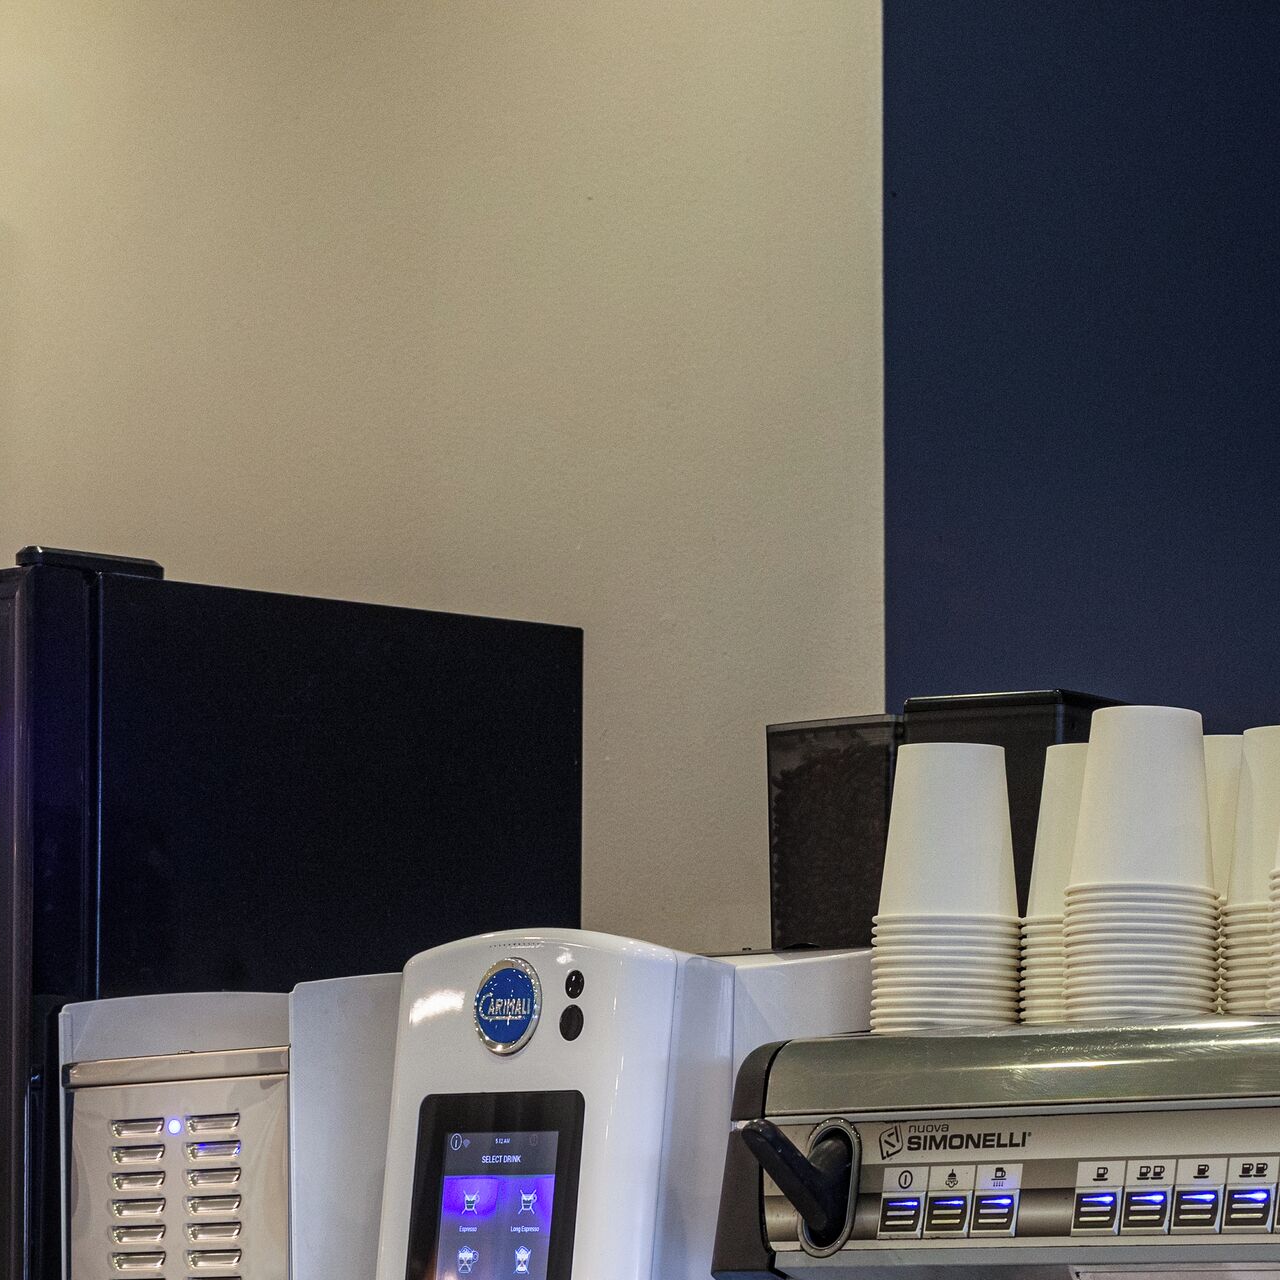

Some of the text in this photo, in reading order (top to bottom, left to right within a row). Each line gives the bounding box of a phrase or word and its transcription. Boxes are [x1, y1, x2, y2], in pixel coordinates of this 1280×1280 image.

[479, 993, 530, 1021] CARIMALI
[908, 1123, 950, 1133] nuova
[907, 1132, 1027, 1151] SIMONELLI
[482, 1154, 522, 1164] SELECT DRINK
[511, 1225, 540, 1234] Long Espresso
